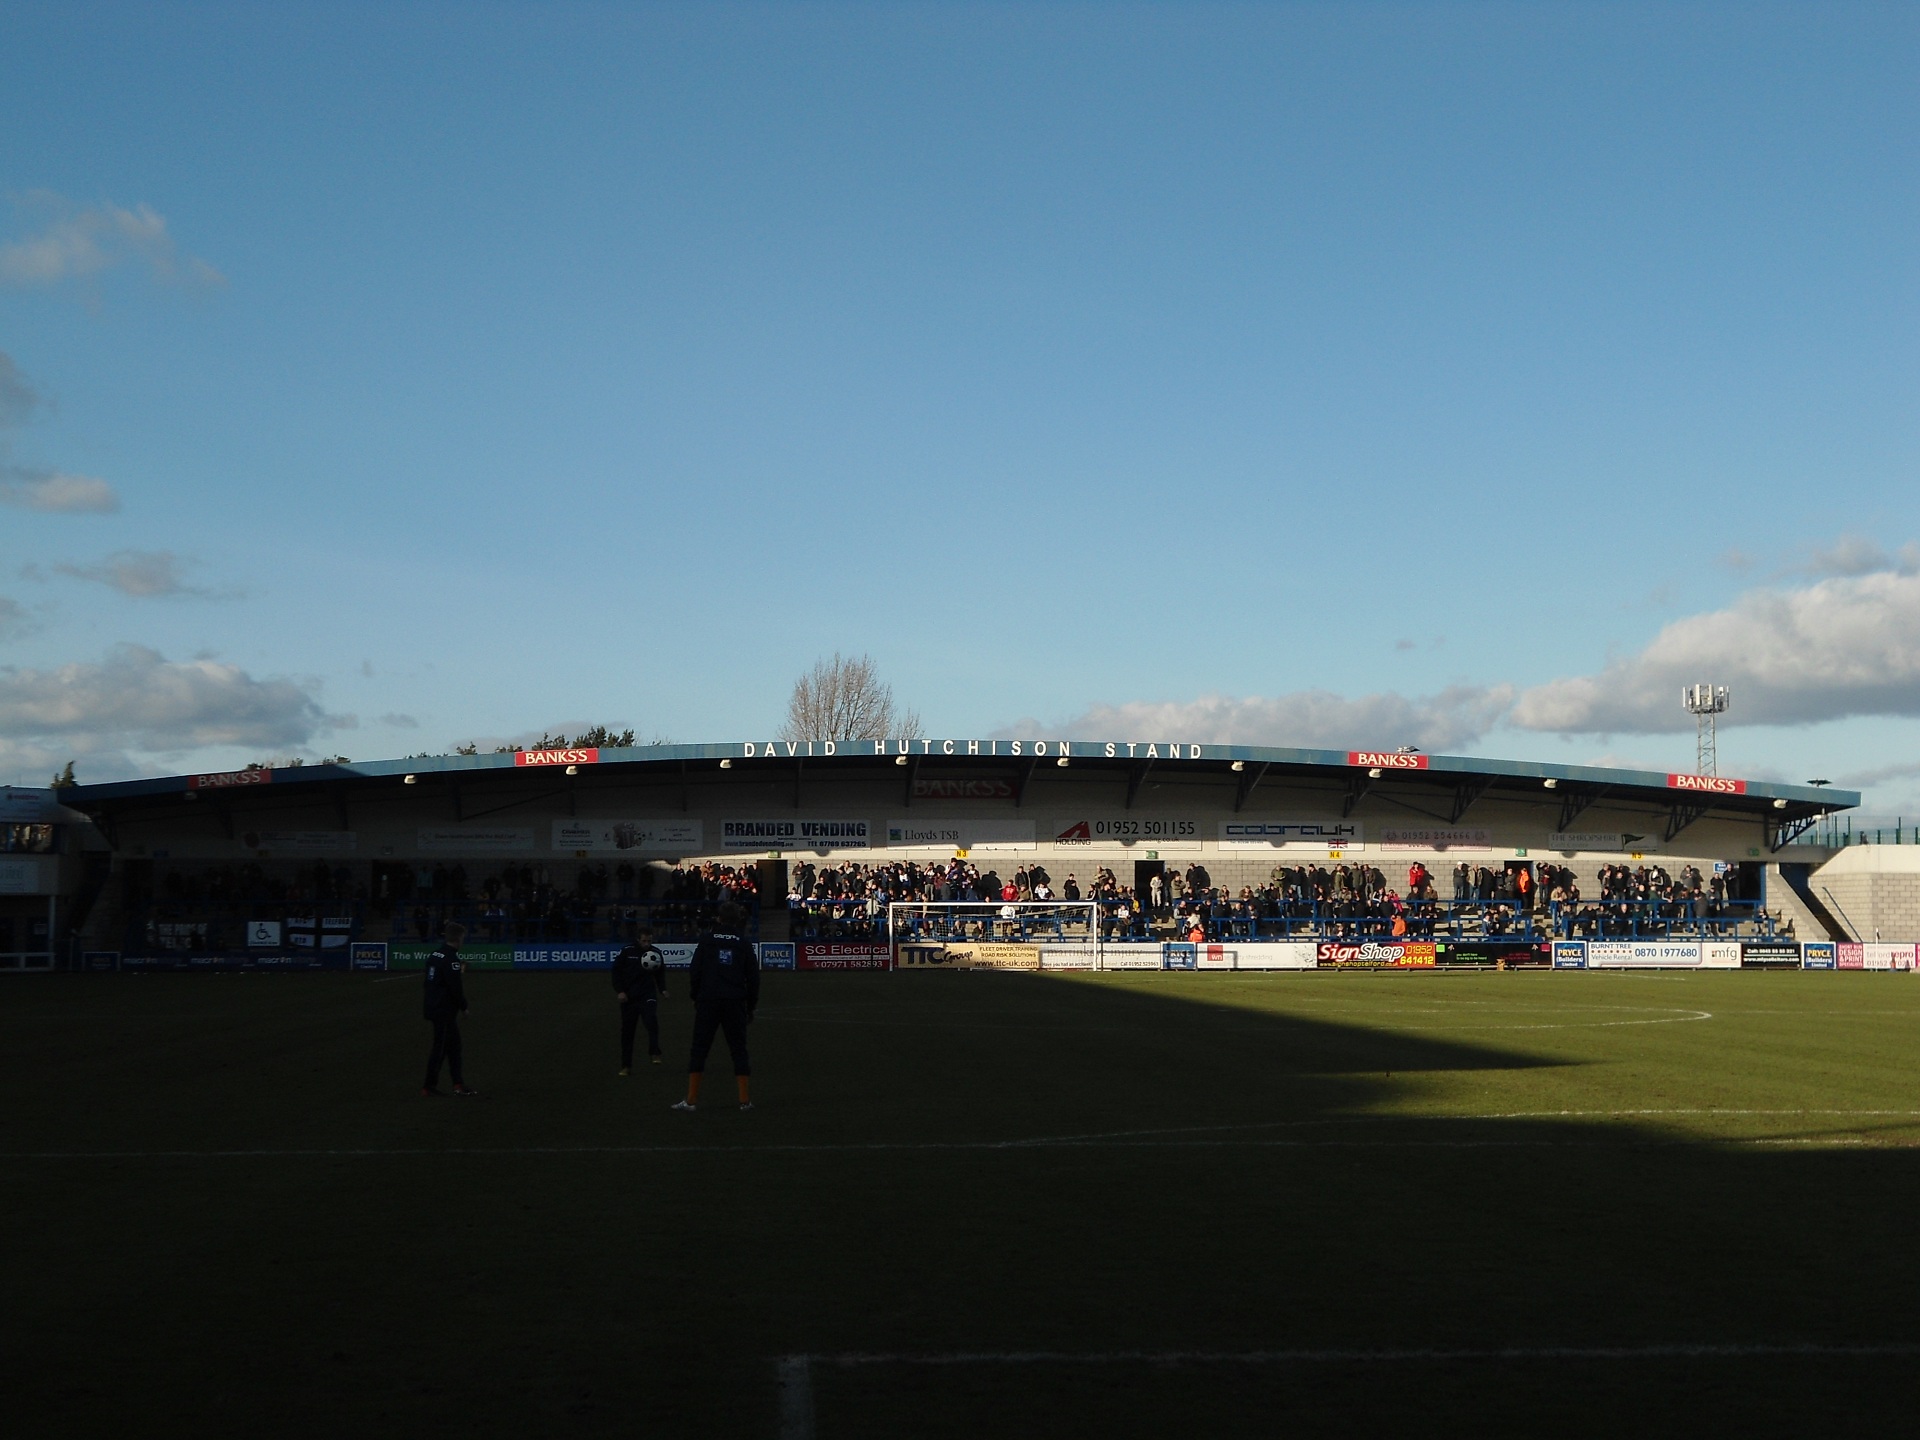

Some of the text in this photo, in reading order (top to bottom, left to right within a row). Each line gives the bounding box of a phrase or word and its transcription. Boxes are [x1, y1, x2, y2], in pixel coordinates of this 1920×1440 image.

[744, 739, 1202, 759] DAVID HUTCHISON STAND
[525, 750, 588, 765] BANKS'S
[1357, 753, 1419, 768] BANKS'S
[1676, 775, 1737, 793] BANKS'S
[724, 822, 867, 837] BRANDED VENDING
[1096, 821, 1195, 835] 01952 501155
[904, 830, 938, 843] Lloyds
[939, 830, 959, 840] TSB
[1402, 831, 1430, 840] 01952
[1055, 838, 1092, 846] HOLDING
[765, 950, 790, 958] PRYCE
[805, 945, 826, 955] SG
[1406, 945, 1433, 954] 01952
[1557, 949, 1582, 957] PRYCE
[1634, 948, 1697, 957] 0870 1977680
[1807, 949, 1832, 957] PRYCE
[392, 951, 411, 960] The
[456, 951, 487, 962] ousing
[489, 951, 512, 960] Trust
[513, 951, 548, 962] BLUE
[551, 951, 607, 963] SQUARE
[901, 946, 974, 965] TTC Group
[1591, 953, 1633, 961] Vehicle Rental
[821, 960, 883, 968] 07971 582893
[974, 959, 1038, 967] www.ttc-uk.com
[1400, 956, 1434, 965] 641412
